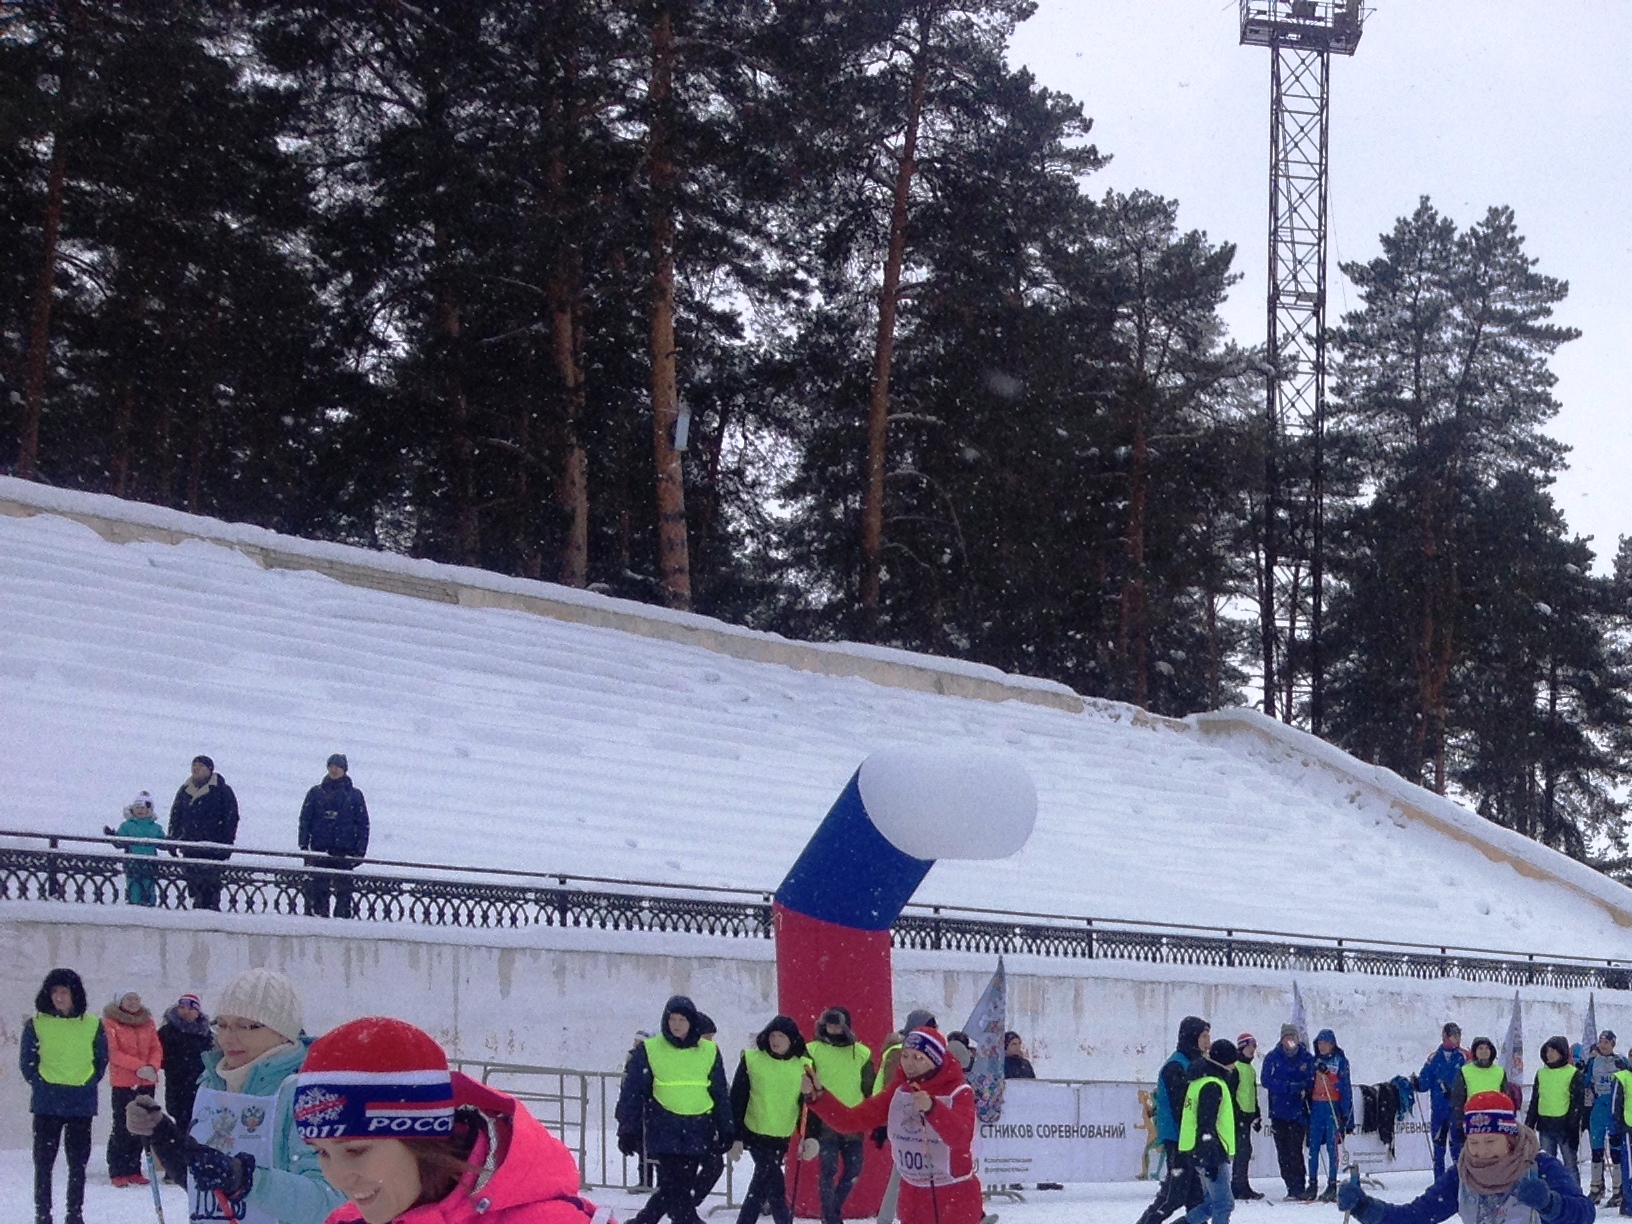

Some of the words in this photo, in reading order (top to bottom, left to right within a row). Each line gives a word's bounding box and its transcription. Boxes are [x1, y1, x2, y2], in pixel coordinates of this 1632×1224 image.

[299, 1124, 347, 1139] 2017
[367, 1117, 455, 1132] РОСС
[980, 1124, 1033, 1139] СТНИКОВ
[1036, 1122, 1126, 1139] СОРЕВНОВАНИЙ
